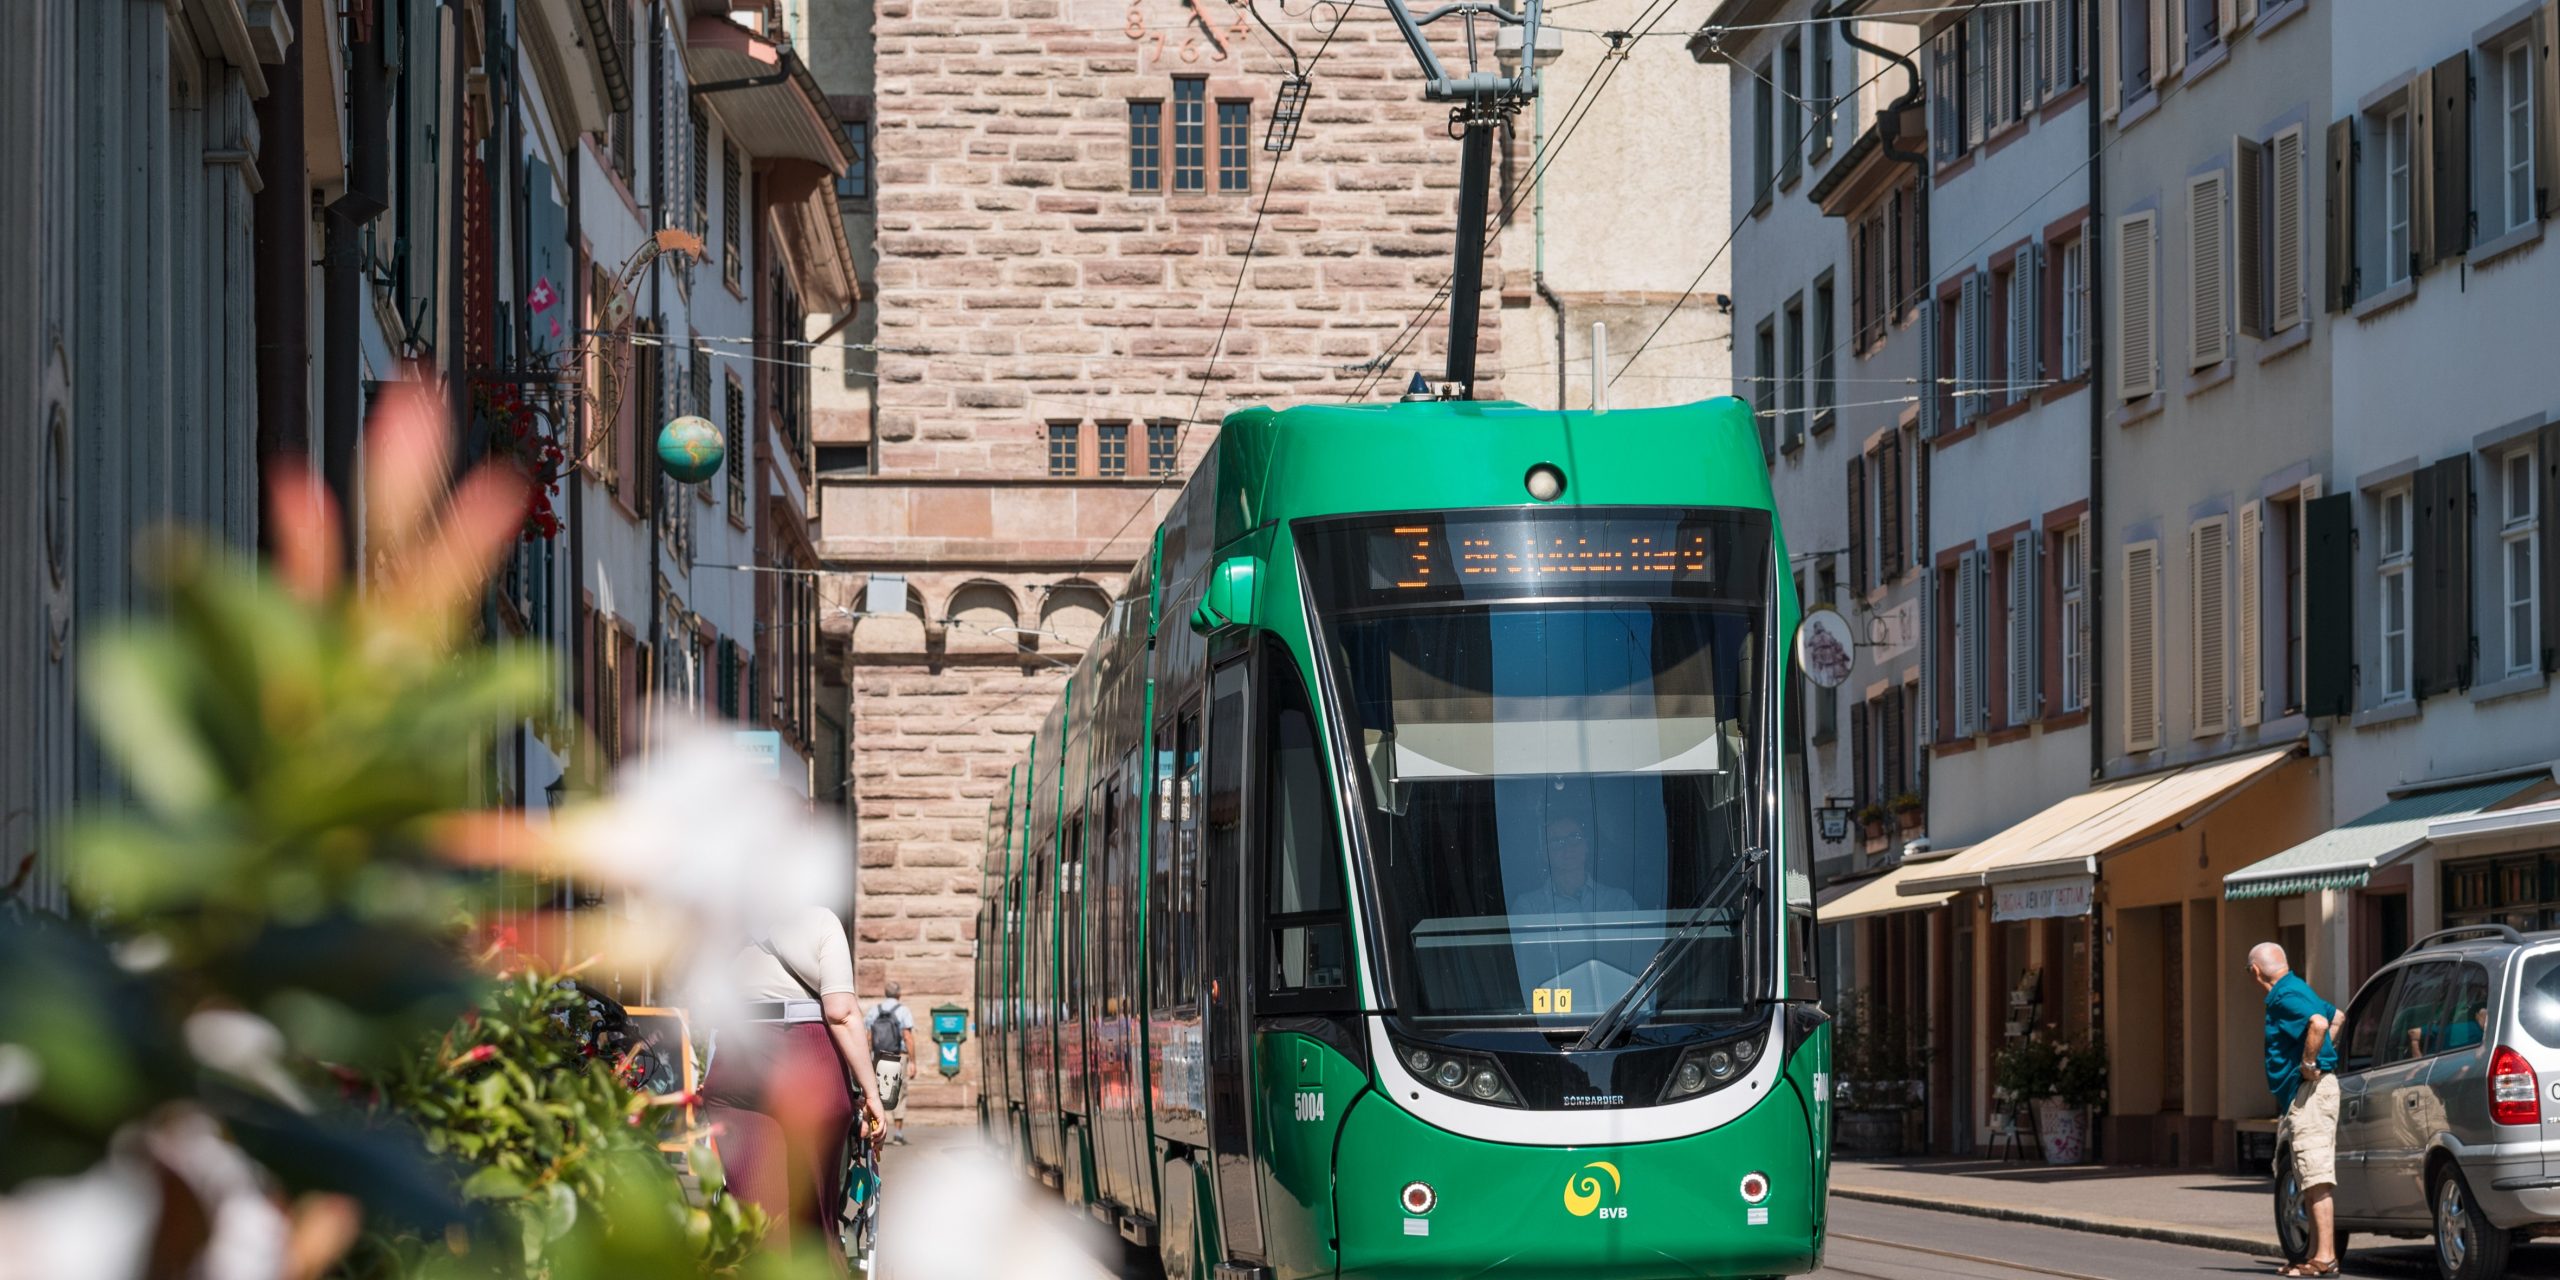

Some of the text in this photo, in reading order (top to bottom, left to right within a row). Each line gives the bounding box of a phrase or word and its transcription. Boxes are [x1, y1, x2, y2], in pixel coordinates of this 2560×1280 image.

[1125, 10, 1146, 39] 8
[1150, 32, 1166, 63] 7
[1180, 38, 1200, 63] 6
[1394, 527, 1429, 588] 3
[1559, 995, 1567, 1008] 0
[1294, 1092, 1325, 1122] 5004
[1563, 1095, 1624, 1106] BOMBARDIER
[1599, 1207, 1628, 1219] BVB
